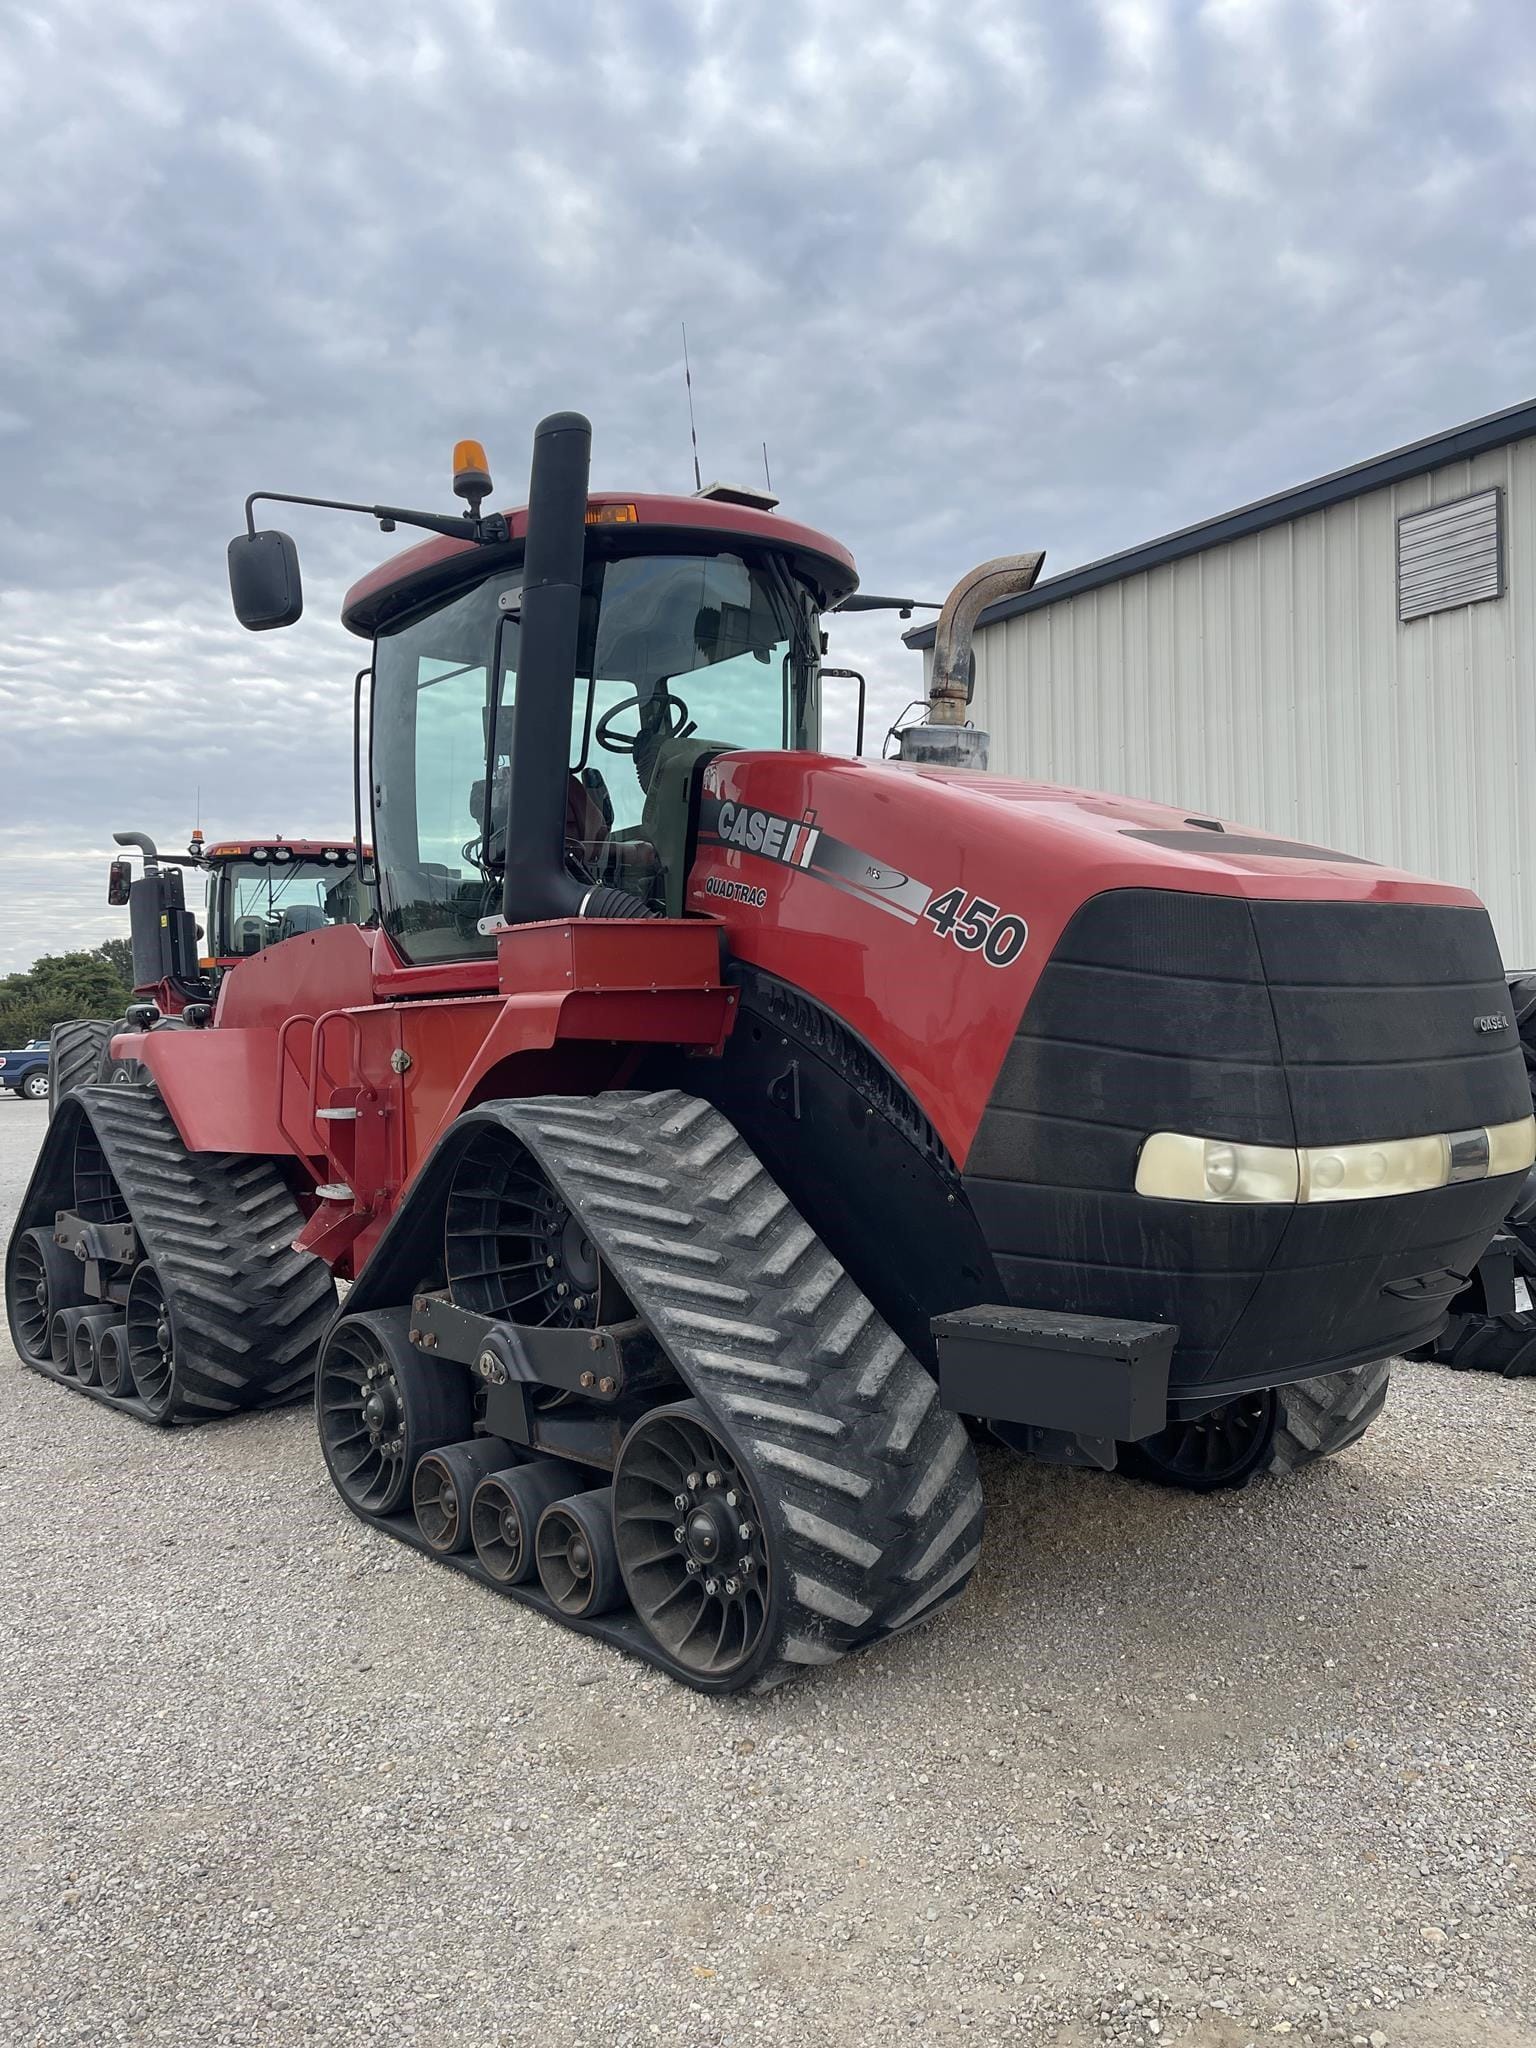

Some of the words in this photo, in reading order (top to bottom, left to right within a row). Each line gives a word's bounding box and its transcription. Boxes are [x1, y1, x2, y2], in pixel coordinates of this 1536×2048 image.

[718, 801, 787, 858] CASE
[705, 876, 767, 908] QUADTRAC
[865, 866, 881, 880] AFS
[924, 887, 1028, 968] 450
